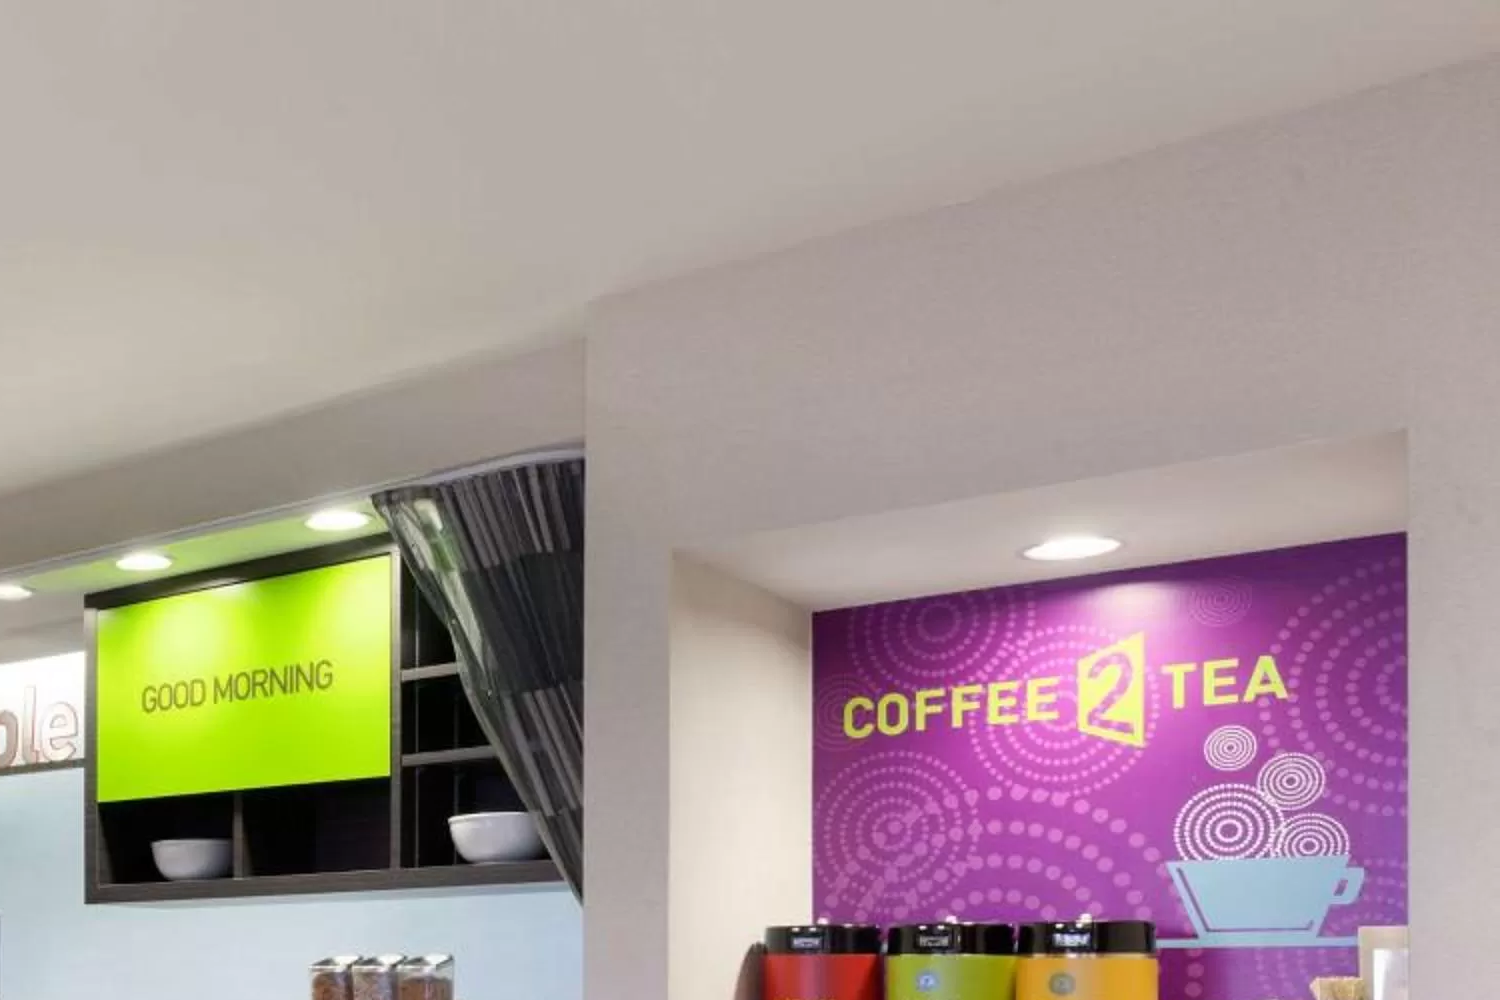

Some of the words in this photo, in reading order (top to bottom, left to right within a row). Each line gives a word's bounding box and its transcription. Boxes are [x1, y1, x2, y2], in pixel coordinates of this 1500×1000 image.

[141, 678, 207, 714] GOOD
[213, 659, 334, 705] MORNING
[843, 676, 1060, 740] COFFEE
[1085, 652, 1137, 734] 2
[1161, 655, 1289, 709] TEA
